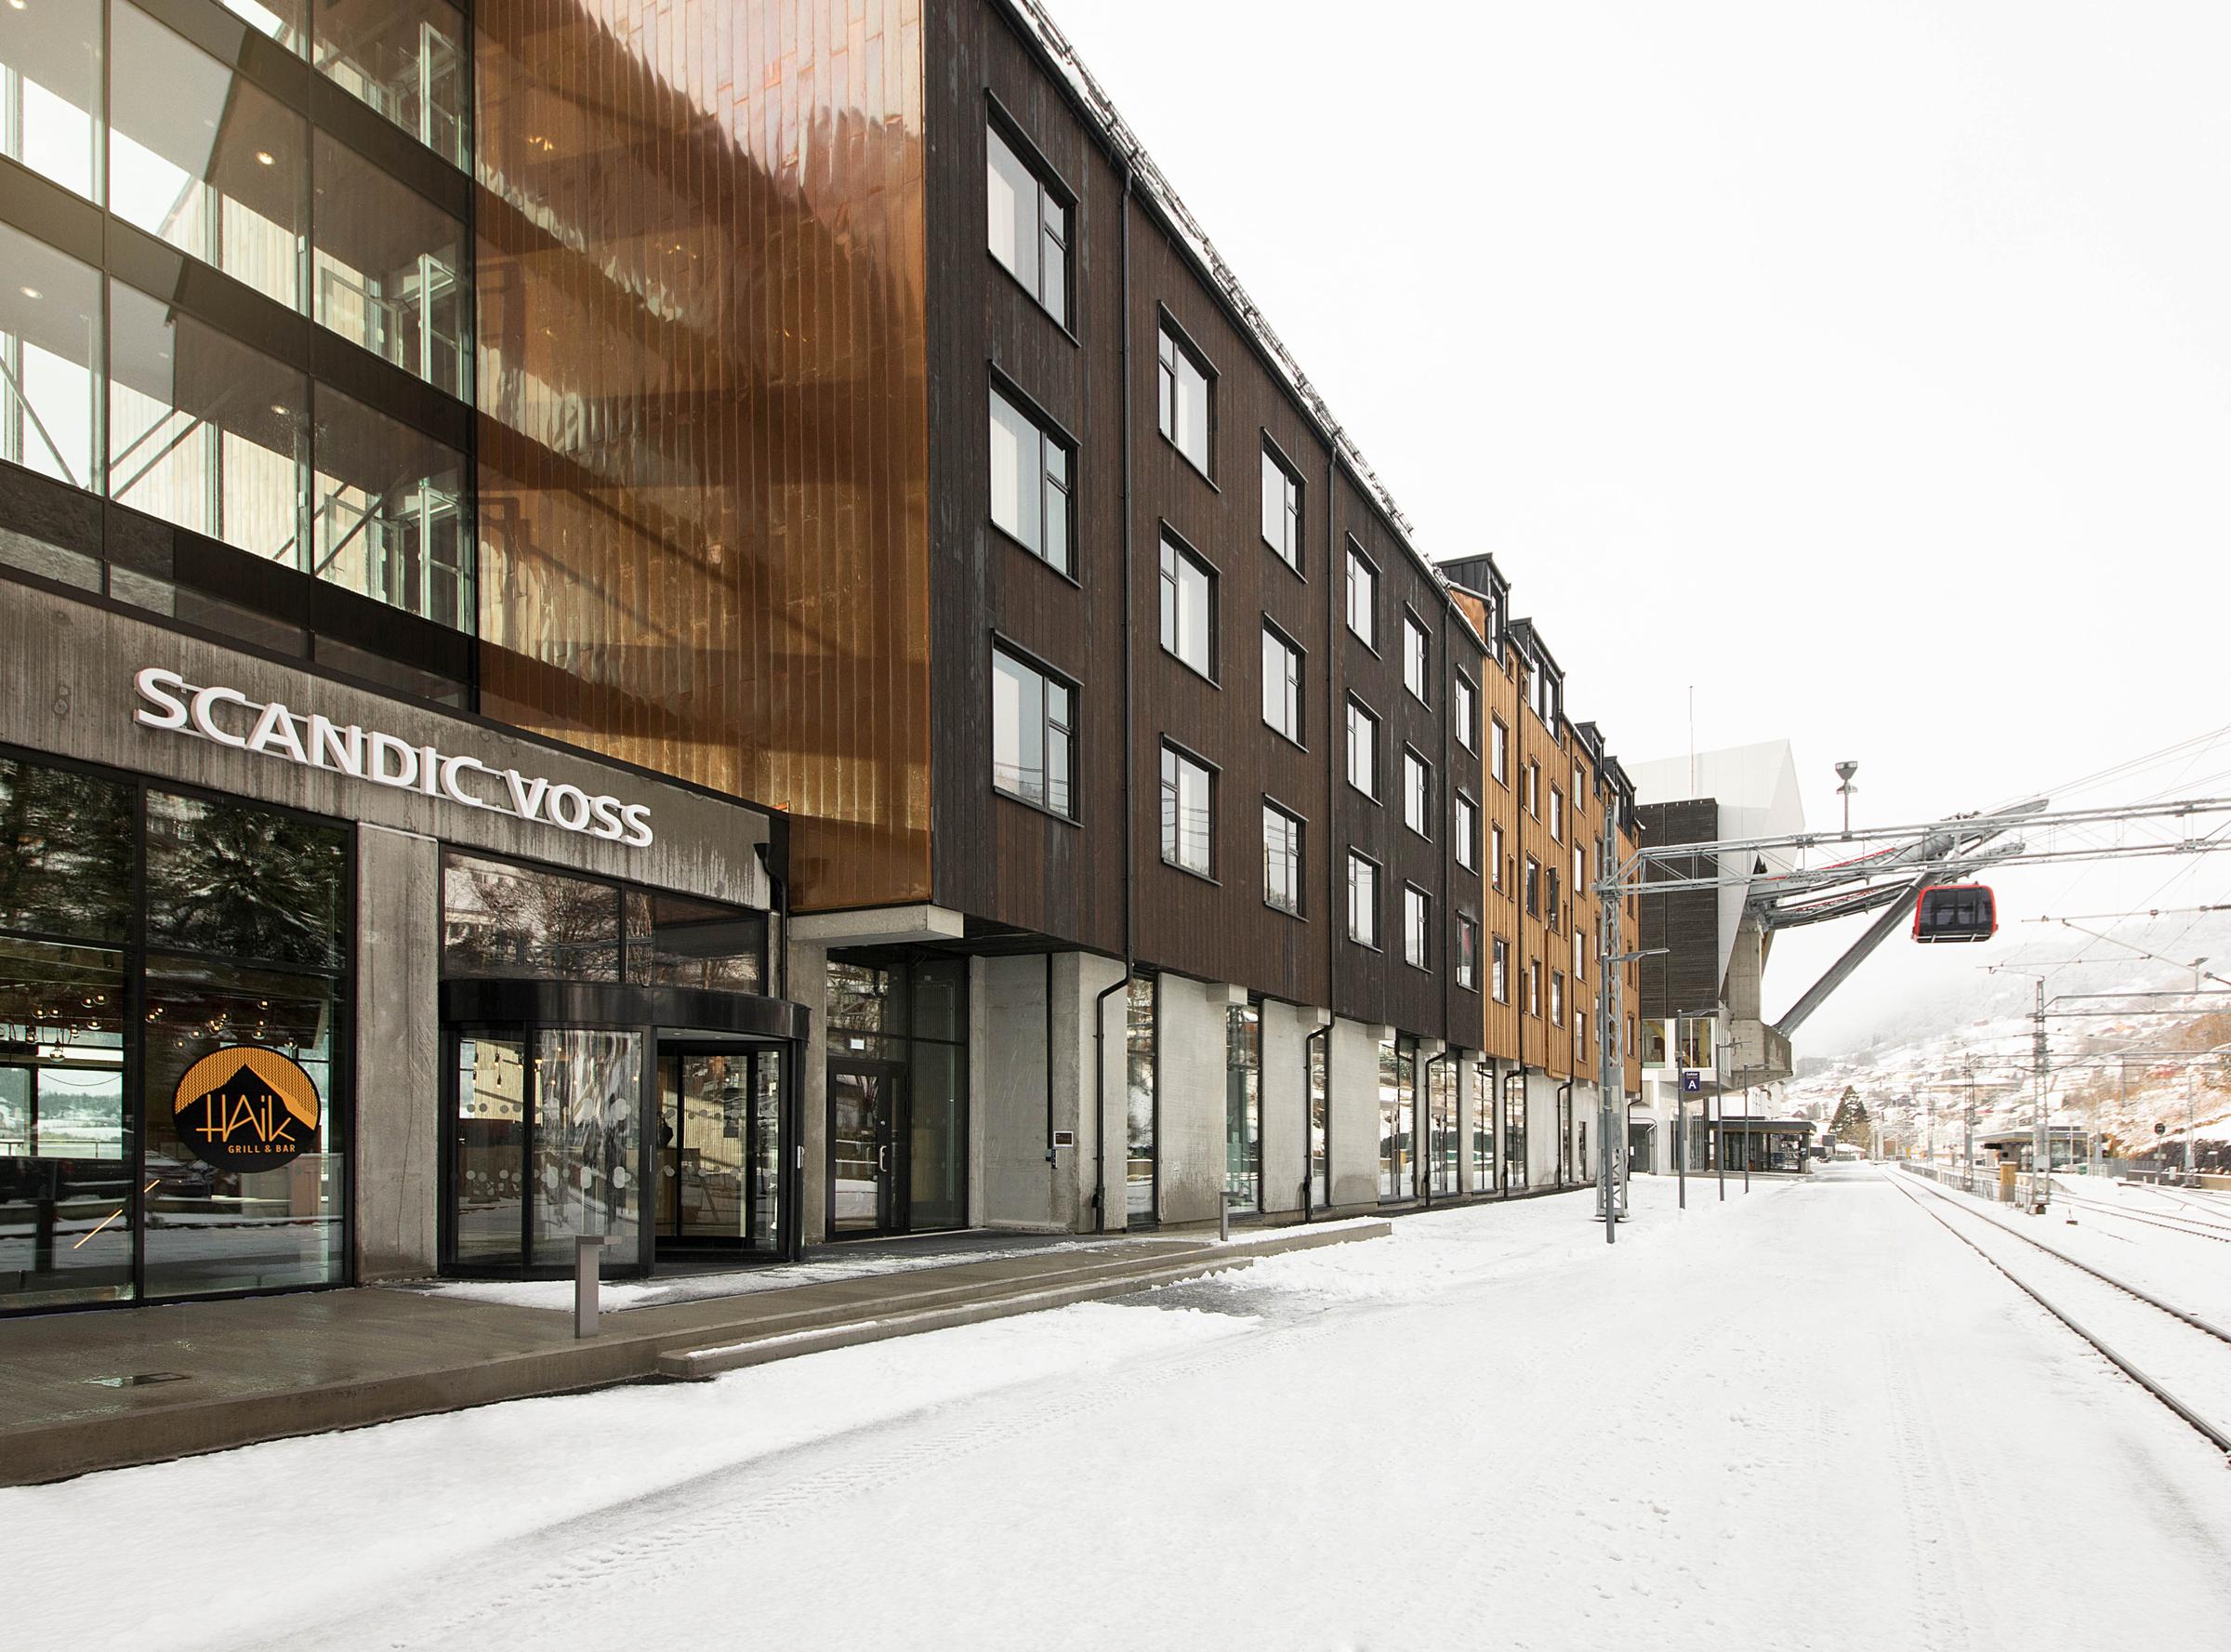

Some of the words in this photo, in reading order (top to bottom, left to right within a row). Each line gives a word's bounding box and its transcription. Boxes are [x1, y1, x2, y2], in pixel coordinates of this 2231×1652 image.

[133, 667, 484, 808] SCANDIC
[504, 769, 653, 848] VOSS
[1688, 1080, 1696, 1089] A
[228, 1144, 260, 1154] GRILL
[264, 1144, 271, 1153] &
[275, 1144, 296, 1153] BAR
